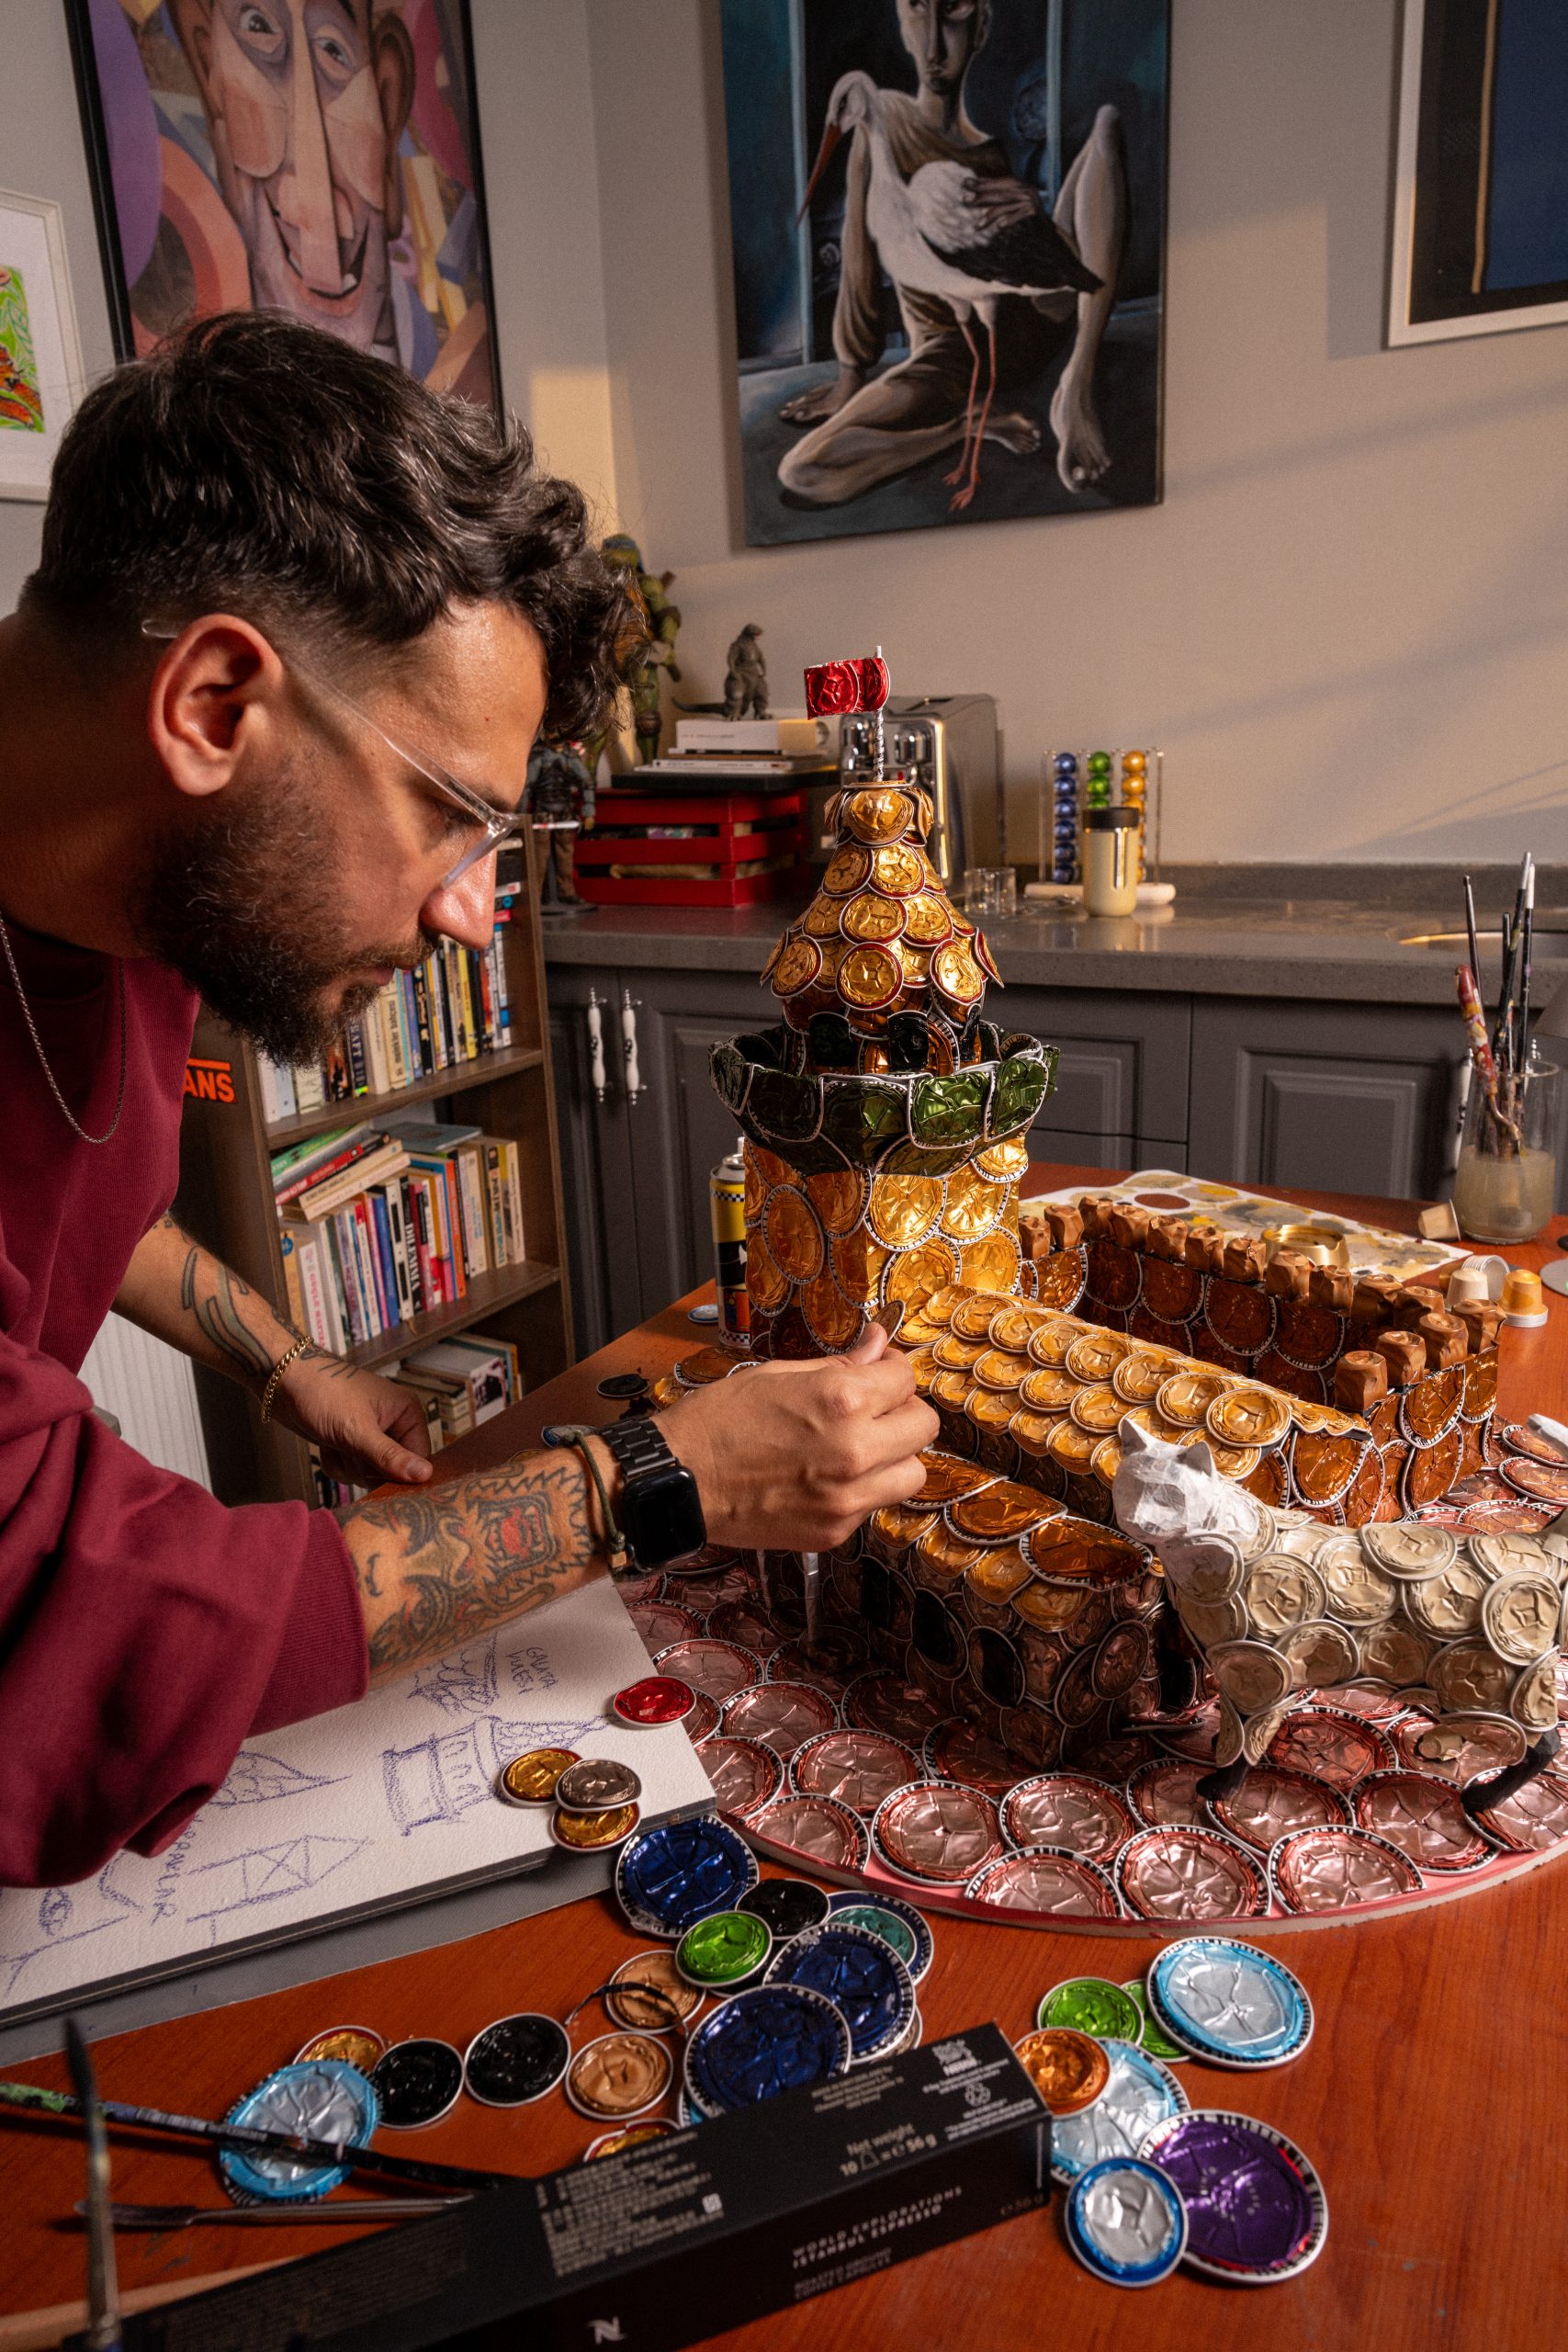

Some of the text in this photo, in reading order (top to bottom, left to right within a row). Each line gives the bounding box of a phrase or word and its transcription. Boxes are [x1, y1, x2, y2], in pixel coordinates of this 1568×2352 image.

[183, 1059, 235, 1103] ANS
[840, 2160, 859, 2177] 10
[906, 2135, 925, 2153] 56
[847, 2123, 915, 2157] Net weight
[792, 2185, 963, 2257] WORLD EXPLORATIONS
[792, 2203, 942, 2269] ISTANBUL ESPRESSO
